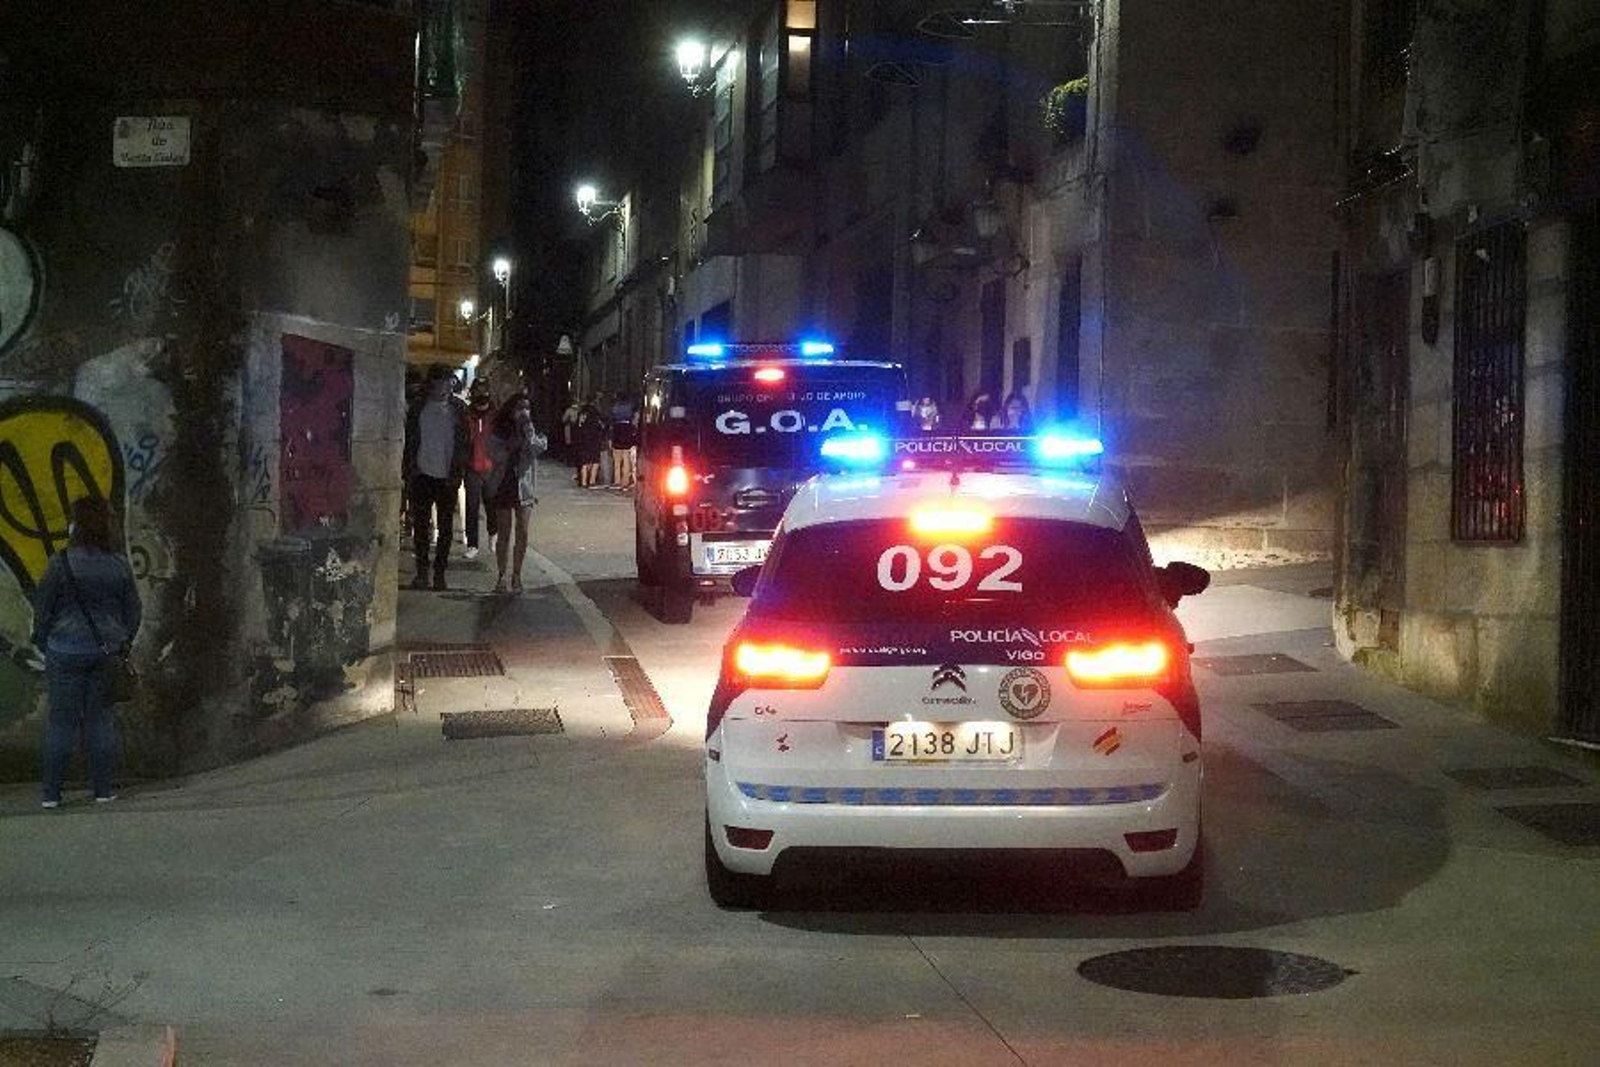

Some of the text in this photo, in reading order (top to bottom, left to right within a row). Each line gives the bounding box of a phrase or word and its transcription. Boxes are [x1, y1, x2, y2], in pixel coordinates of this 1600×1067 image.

[715, 407, 868, 435] G.O.A.
[974, 441, 1025, 453] LOCAL
[876, 543, 1024, 593] 092
[950, 628, 1094, 644] POLICÍA LOCAL
[1005, 649, 1046, 661] VIGO
[889, 732, 956, 757] 2138
[965, 731, 1015, 756] JTJ
